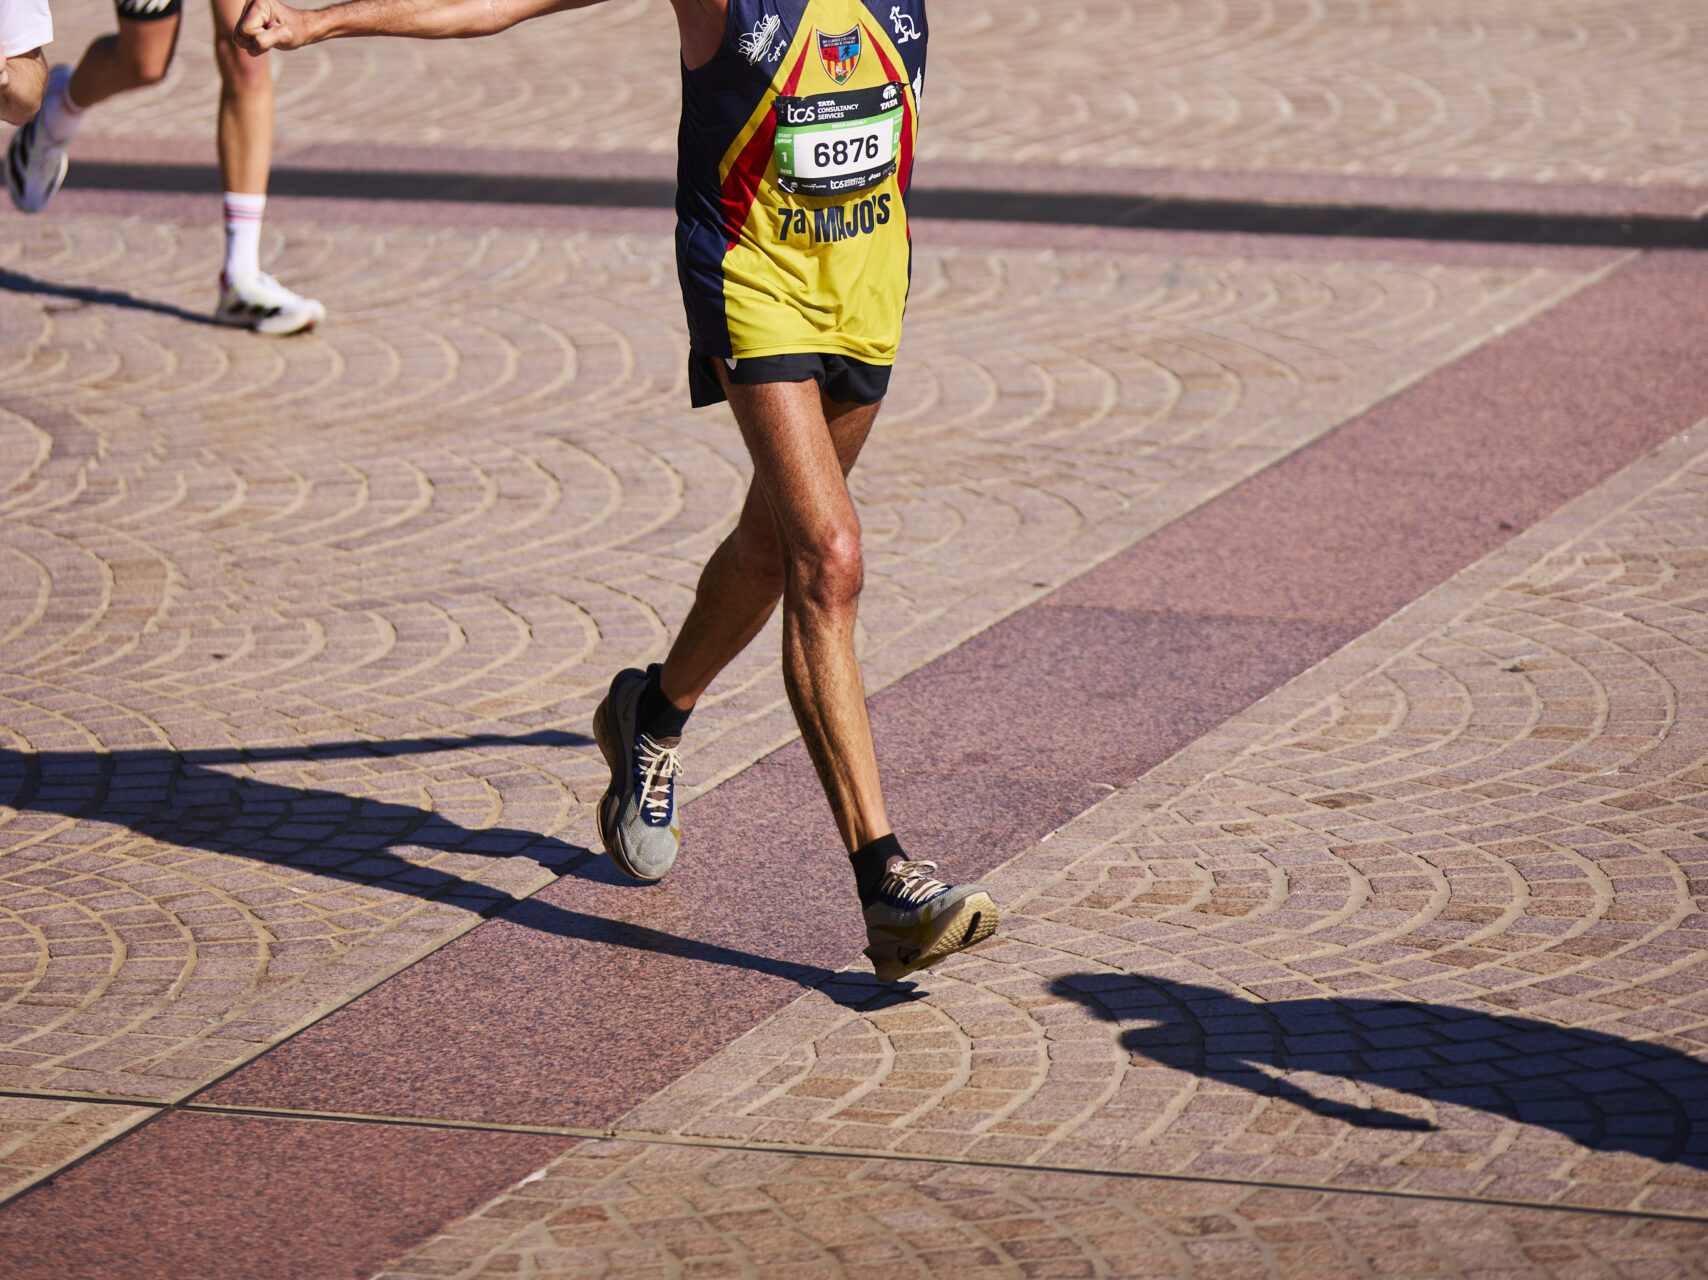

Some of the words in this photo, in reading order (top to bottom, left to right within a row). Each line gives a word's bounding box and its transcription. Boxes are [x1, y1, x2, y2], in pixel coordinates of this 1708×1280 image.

[817, 103, 859, 114] CONSULTANCY
[880, 98, 898, 111] TATA
[787, 104, 815, 124] tcs
[817, 111, 845, 121] SERVICES
[782, 152, 787, 163] 1
[814, 134, 879, 168] 6876
[778, 207, 806, 241] 7a
